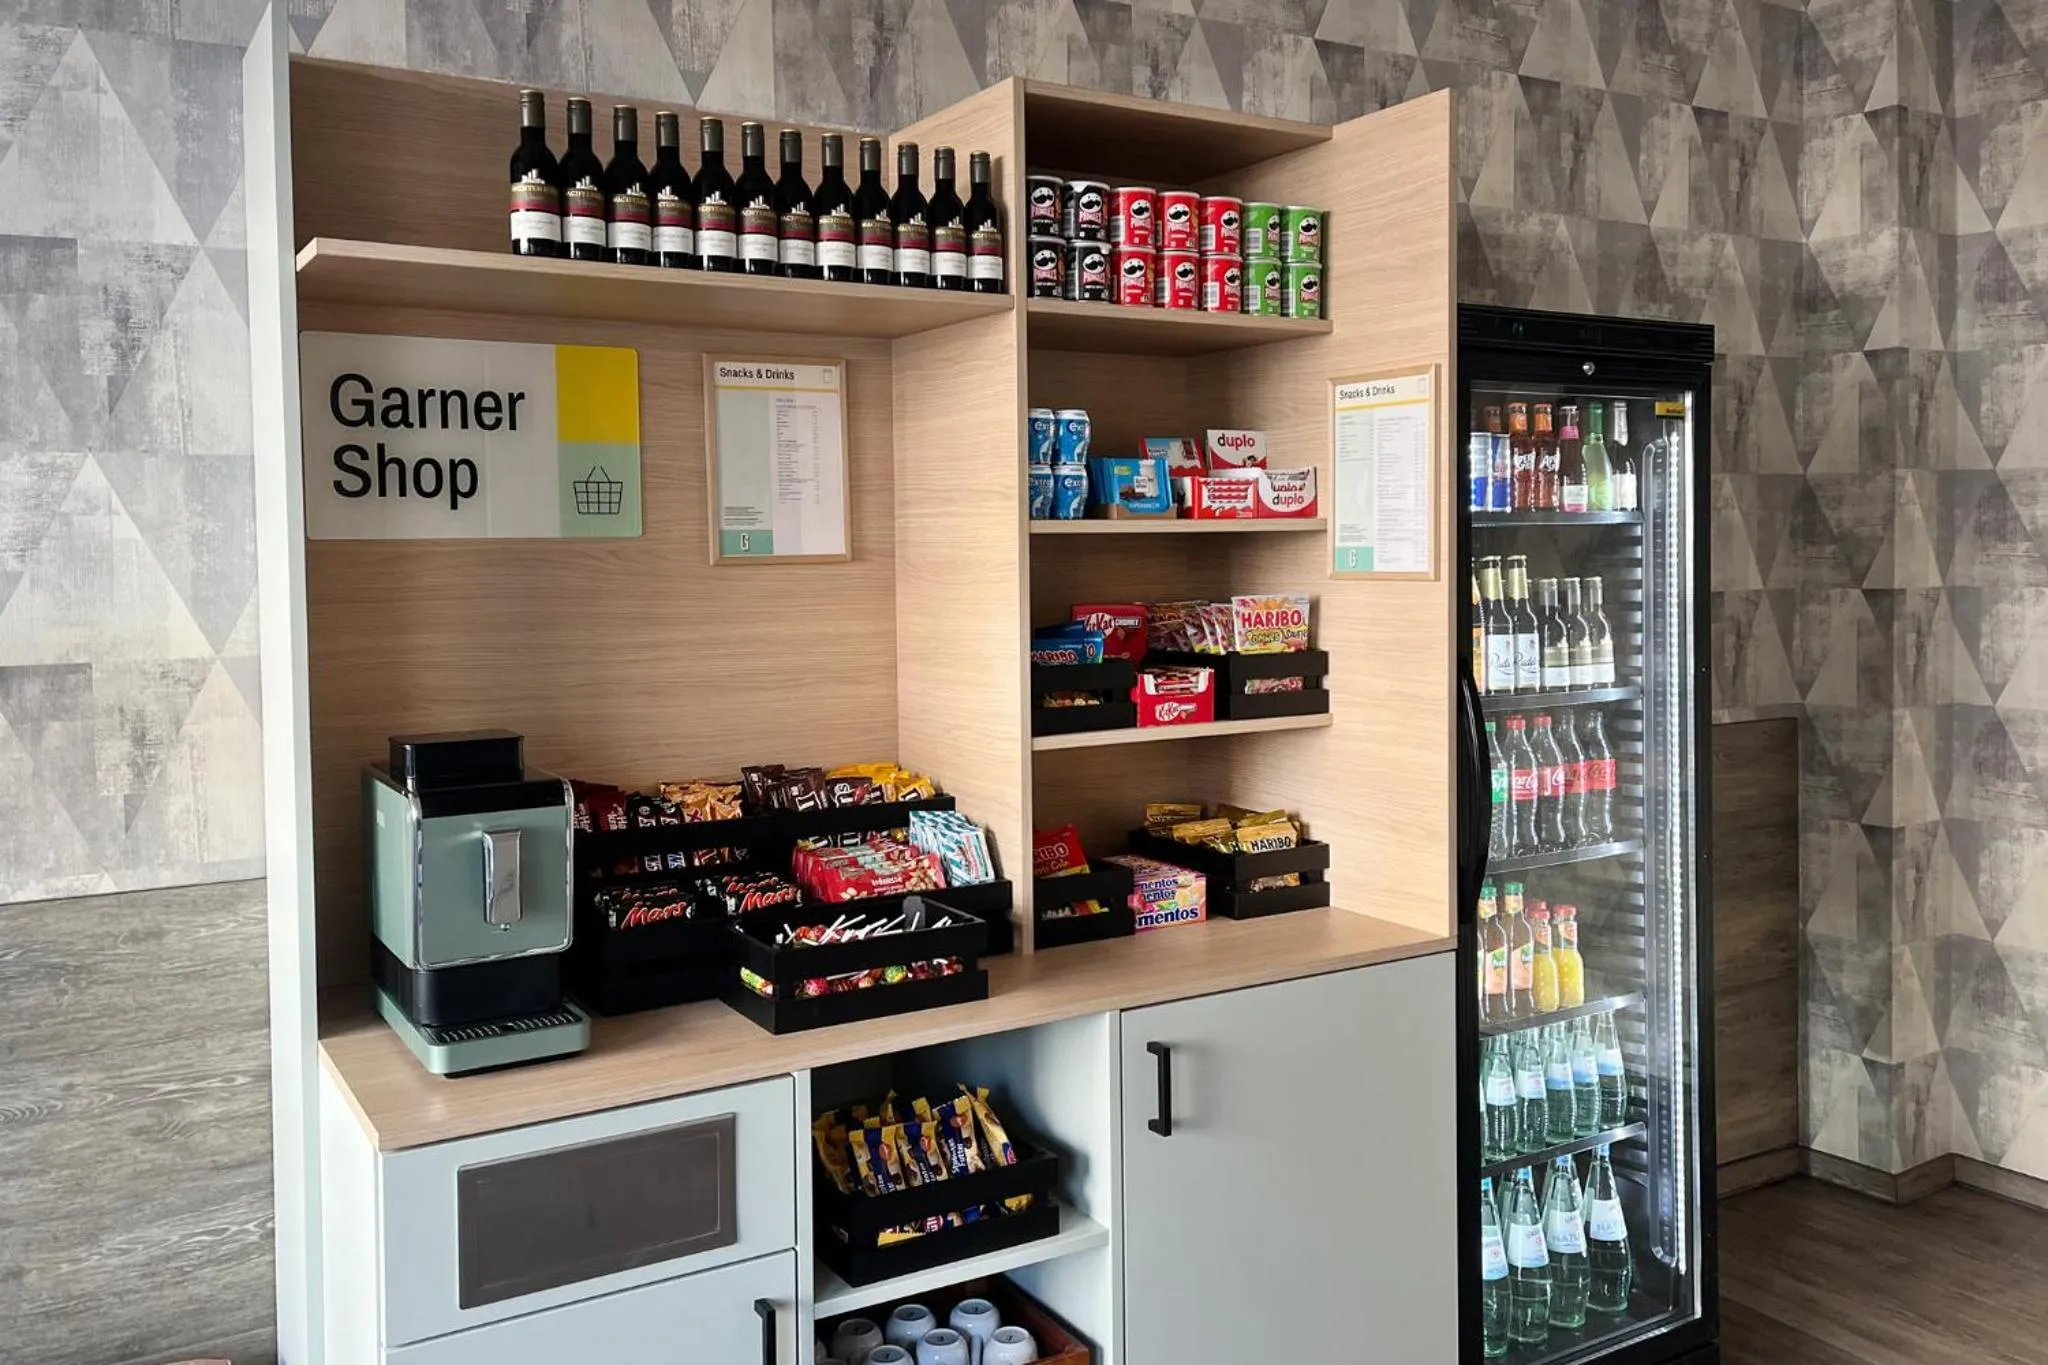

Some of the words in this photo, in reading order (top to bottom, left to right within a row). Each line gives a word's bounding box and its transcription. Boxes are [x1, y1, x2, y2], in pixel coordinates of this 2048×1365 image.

[720, 367, 753, 378] Snacks
[756, 368, 763, 379] &
[765, 369, 795, 380] Drinks
[329, 373, 525, 431] Garner
[1340, 388, 1364, 400] Snacks
[1372, 384, 1395, 396] Drinks
[1217, 433, 1255, 450] duplo
[332, 443, 479, 510] Shop
[1272, 493, 1304, 508] duplo
[1241, 609, 1302, 629] HARIBO
[1251, 836, 1292, 851] HARIBO
[738, 887, 798, 914] Mars
[620, 901, 687, 931] Mars
[1136, 906, 1199, 928] mentos
